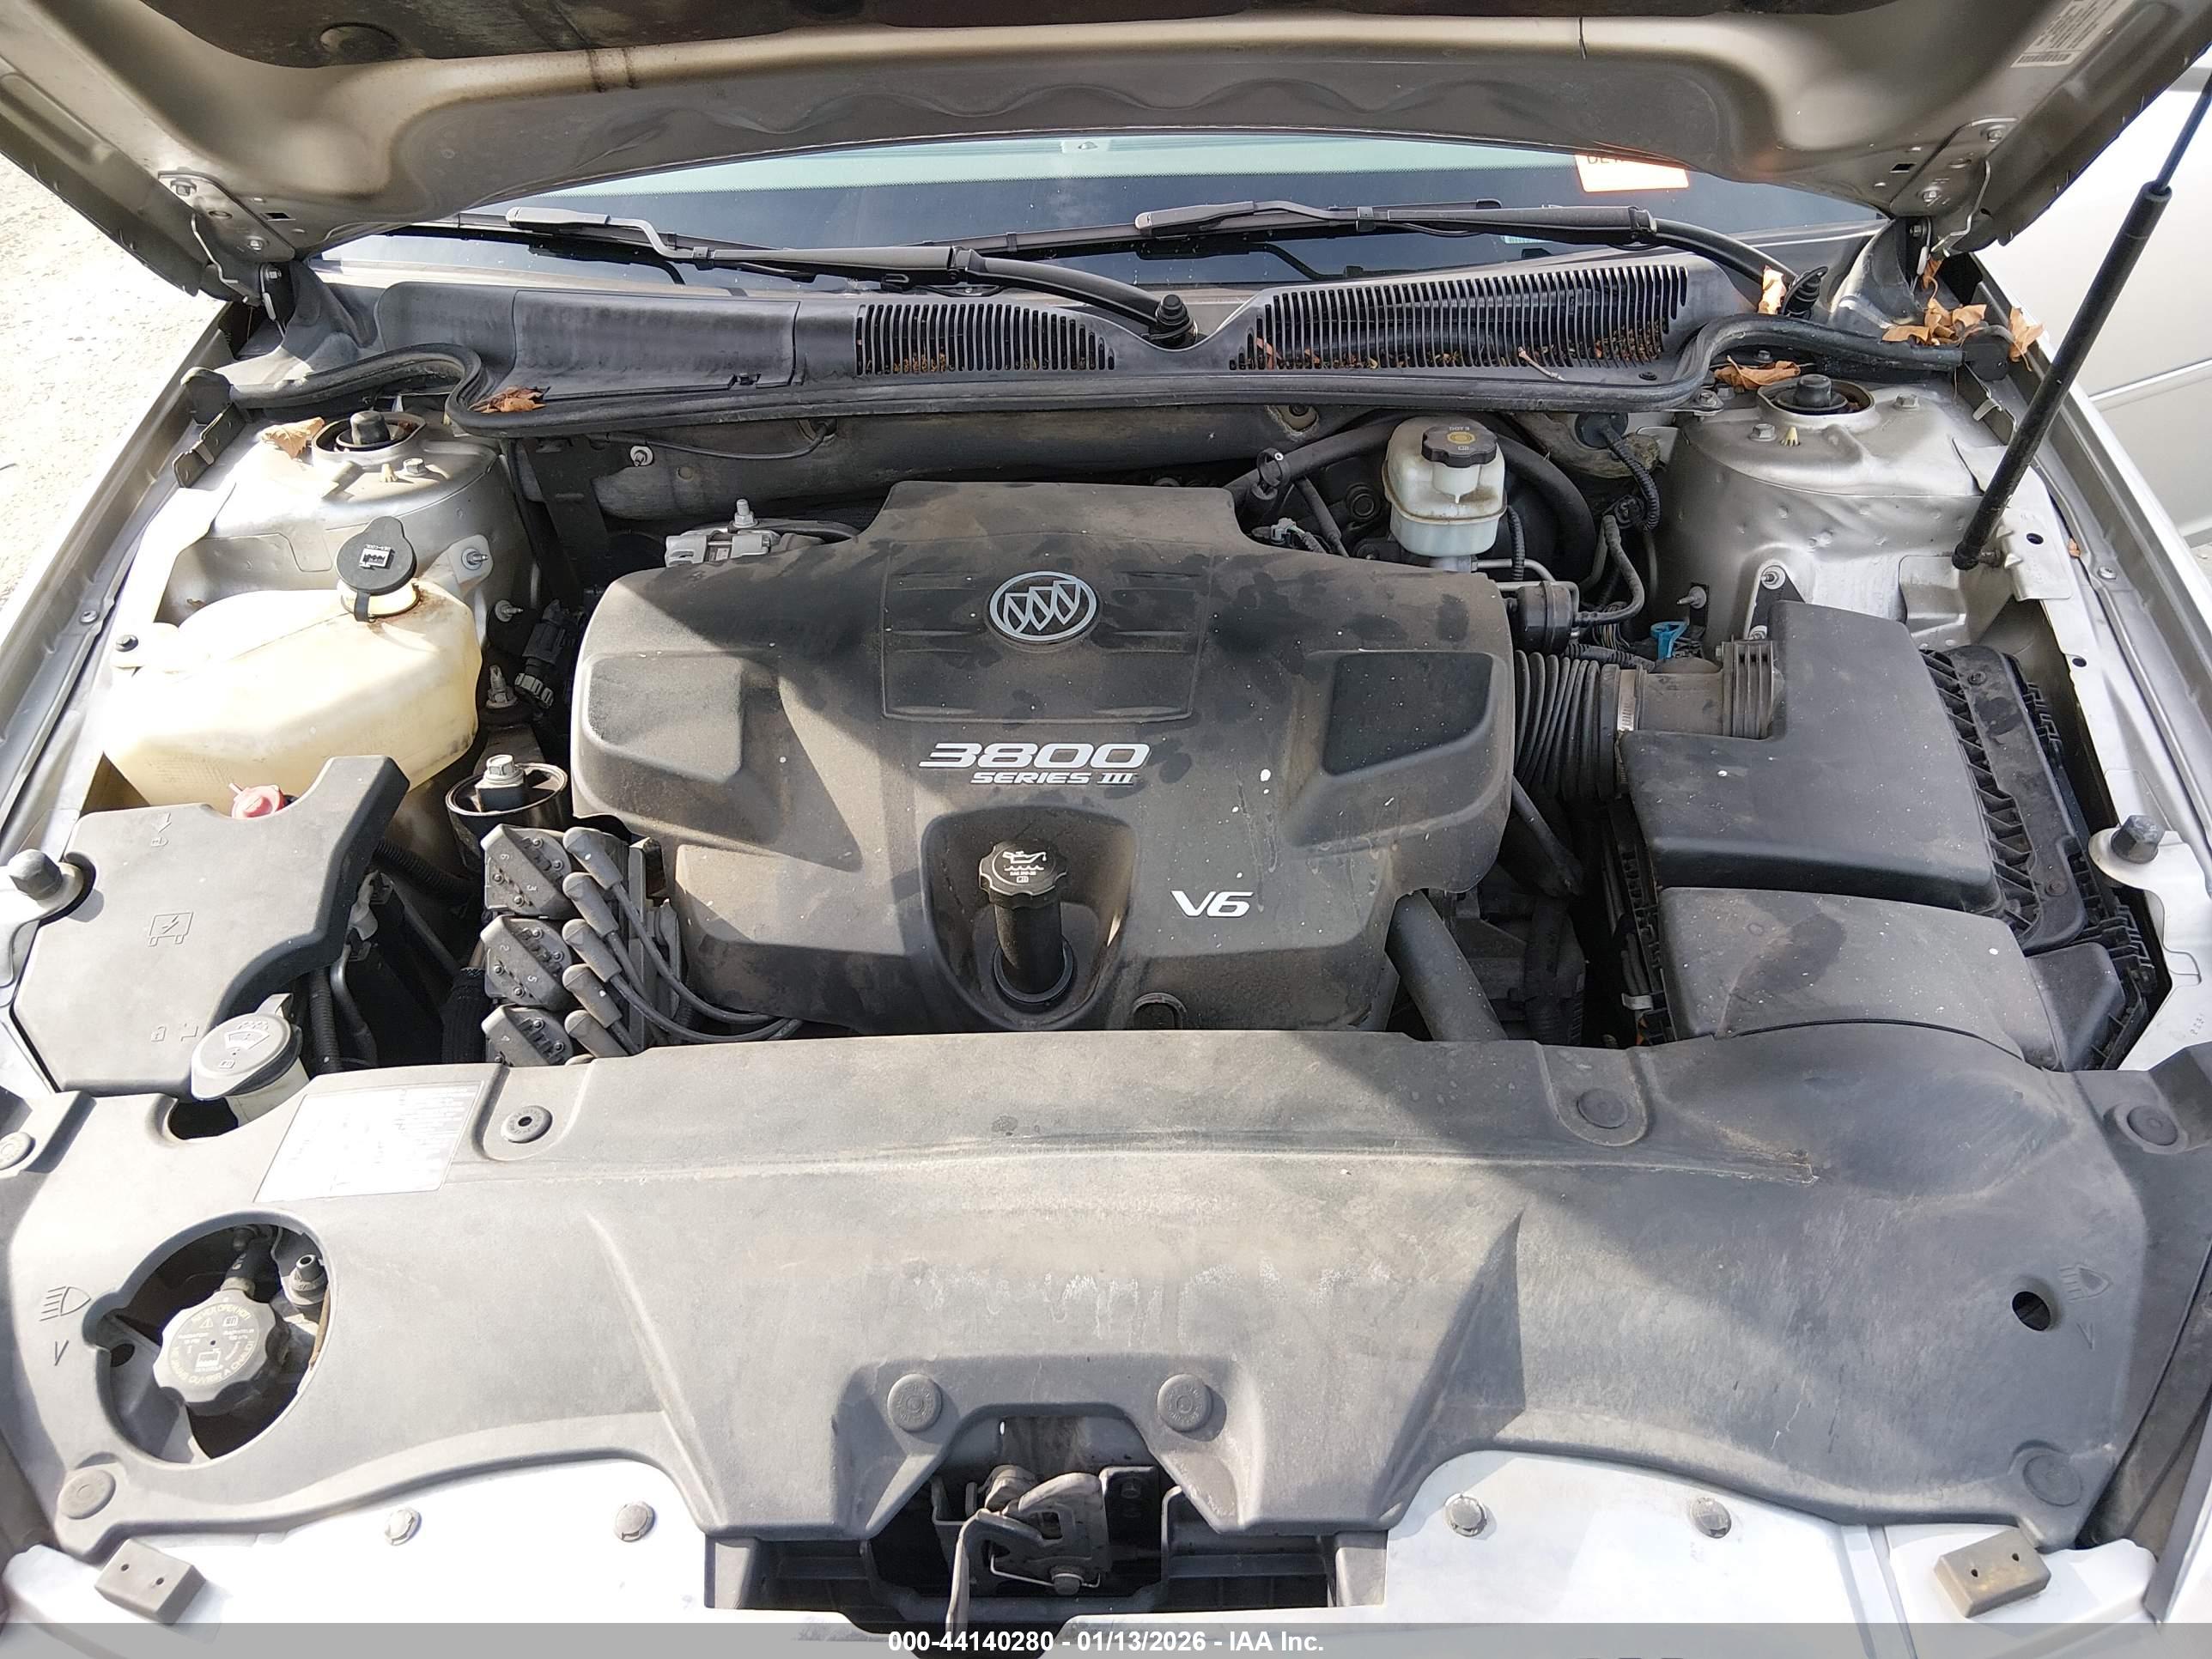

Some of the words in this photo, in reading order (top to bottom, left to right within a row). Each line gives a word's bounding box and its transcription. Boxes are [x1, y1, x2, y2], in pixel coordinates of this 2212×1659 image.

[918, 743, 1151, 769] 3800
[969, 772, 1092, 785] SERIES
[1096, 773, 1139, 786] III
[1170, 890, 1254, 917] V6
[217, 1304, 236, 1313] OPEN
